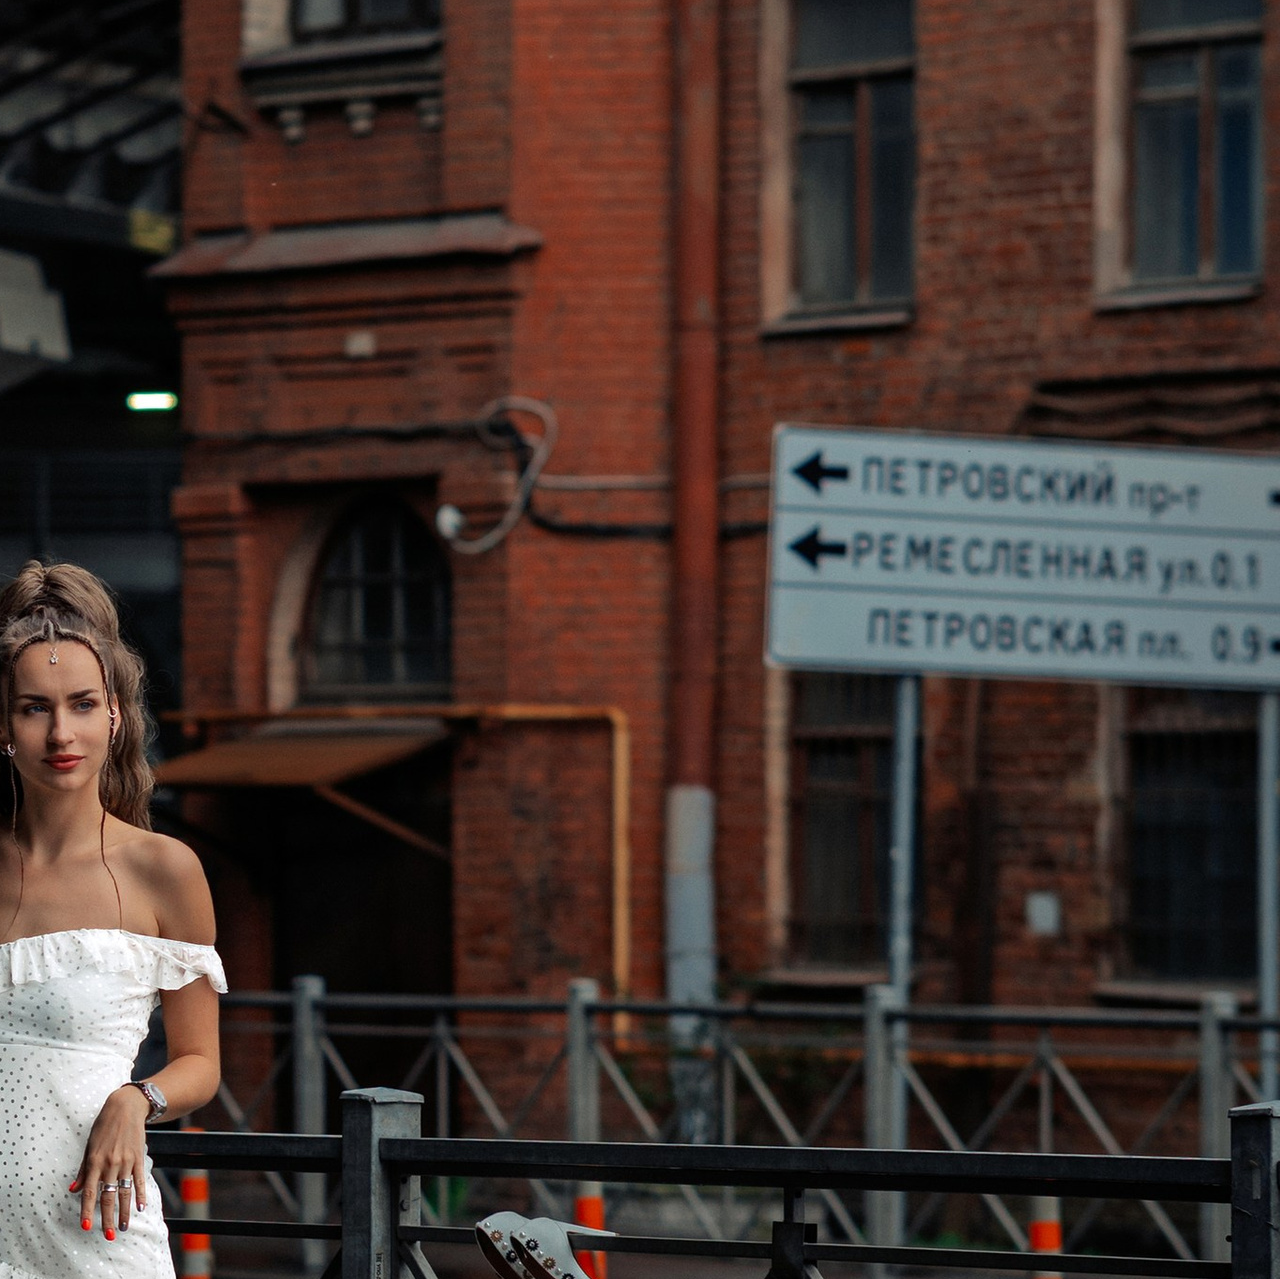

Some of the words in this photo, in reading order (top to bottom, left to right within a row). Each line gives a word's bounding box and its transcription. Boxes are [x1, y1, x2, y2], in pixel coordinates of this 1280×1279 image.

[861, 456, 1115, 506] ПЕТРОВСКИЙ
[1127, 482, 1201, 518] пр-т
[851, 532, 1148, 583] РЕМЕСЛЕННАЯ
[867, 608, 1126, 656] ПЕТРОВСКАЯ
